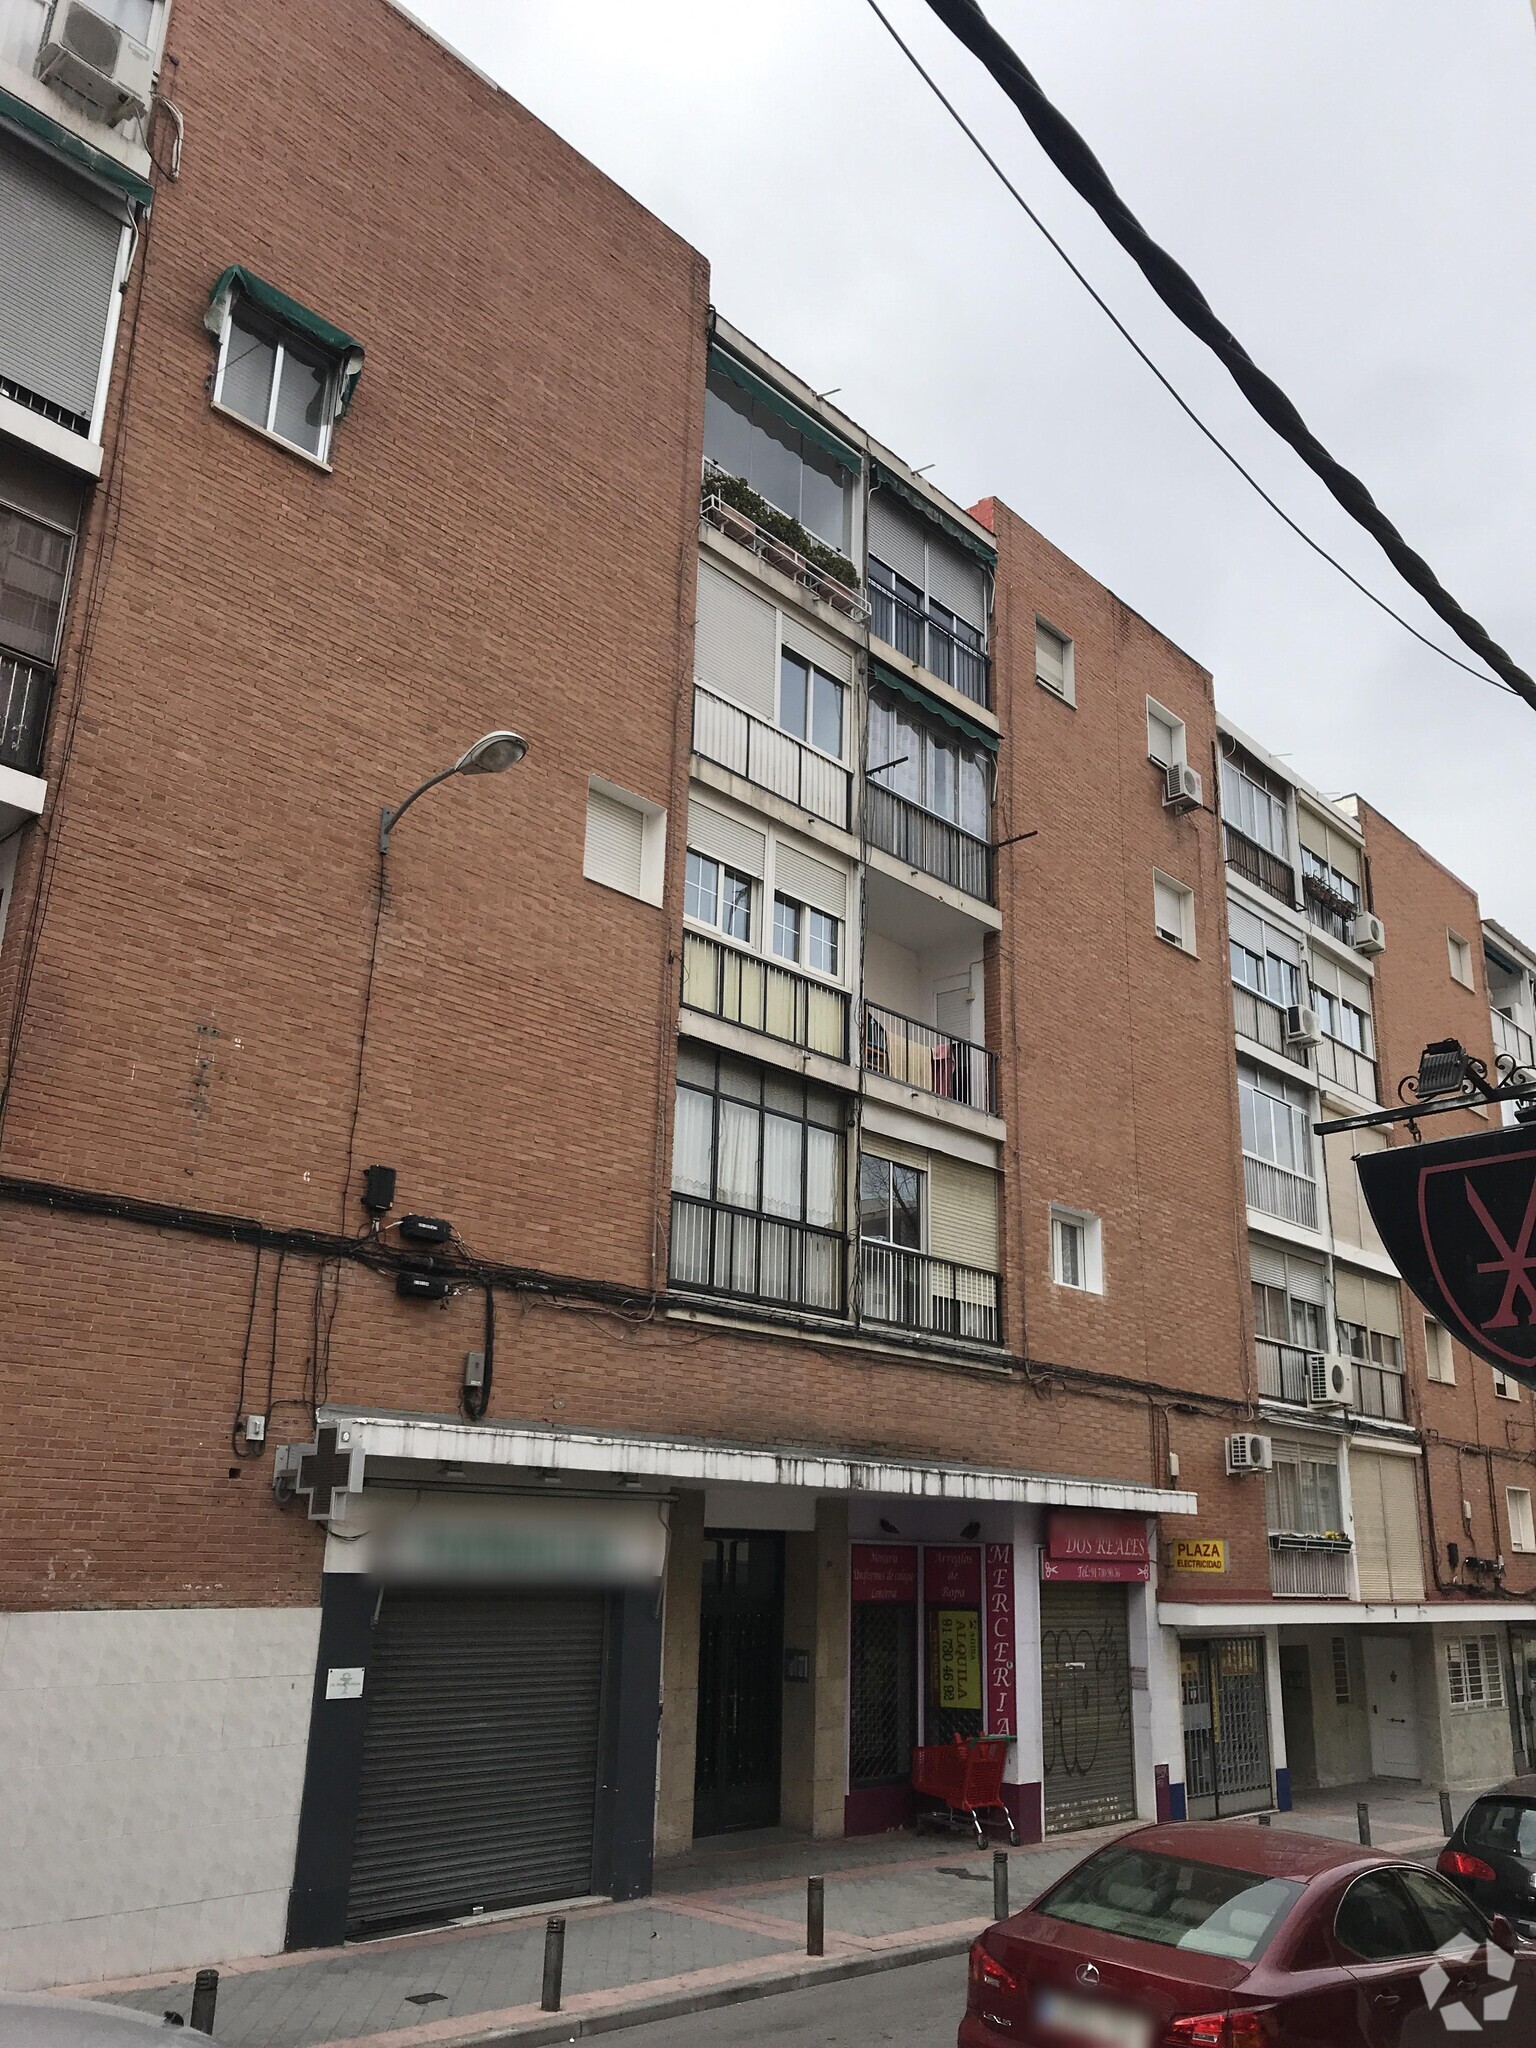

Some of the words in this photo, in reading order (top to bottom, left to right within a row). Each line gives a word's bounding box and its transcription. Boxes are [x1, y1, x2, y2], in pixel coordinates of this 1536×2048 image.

[1065, 1537, 1092, 1554] DOS
[1096, 1537, 1145, 1556] REALES
[1177, 1543, 1220, 1557] PLAZA
[934, 1551, 973, 1567] Arreglos
[1177, 1559, 1222, 1569] ELECTRICIDAD
[947, 1570, 958, 1581] de
[941, 1586, 966, 1601] Ropa
[941, 1618, 953, 1633] 91
[988, 1544, 1011, 1736] MERCERIA
[942, 1638, 954, 1662] 730
[956, 1619, 968, 1700] ALQUILA
[943, 1665, 954, 1681] 46
[943, 1685, 954, 1701] 92
